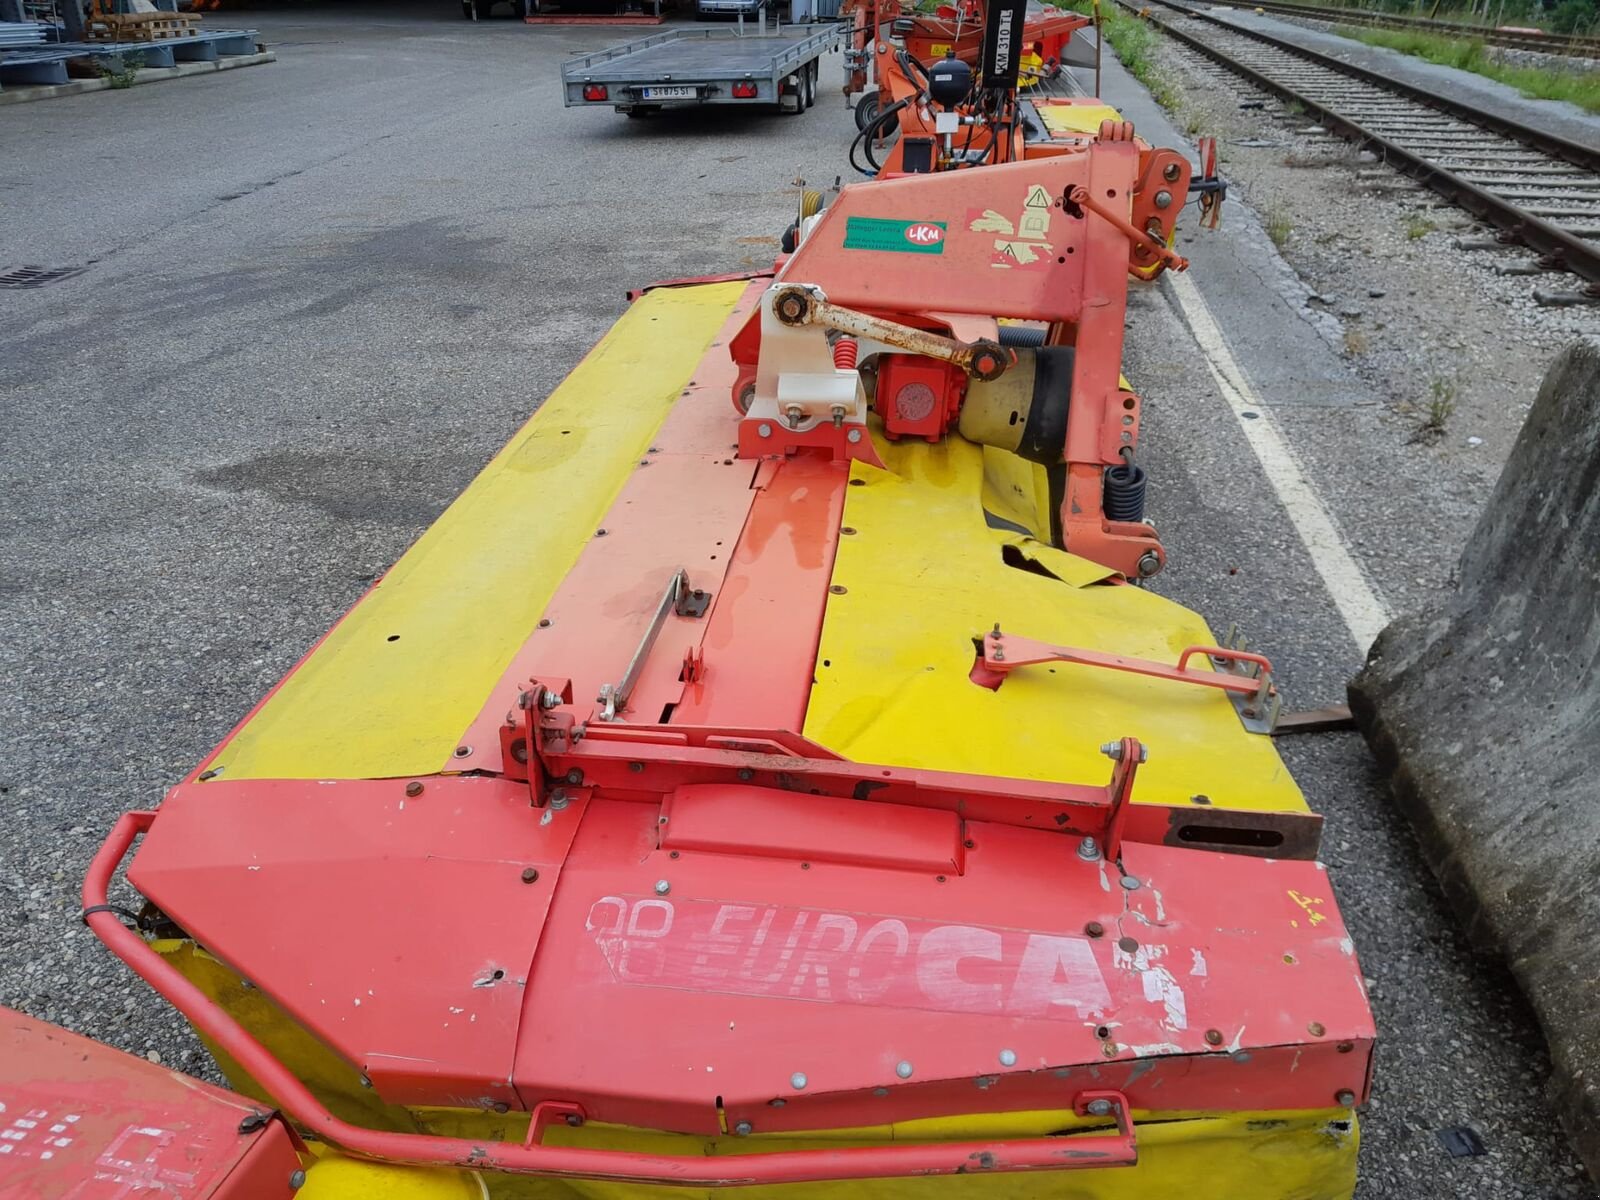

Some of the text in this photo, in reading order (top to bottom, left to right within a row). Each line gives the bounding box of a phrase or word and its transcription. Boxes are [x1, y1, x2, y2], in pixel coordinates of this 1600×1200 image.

[996, 11, 1012, 71] KM 310 TL
[909, 226, 939, 242] LKM
